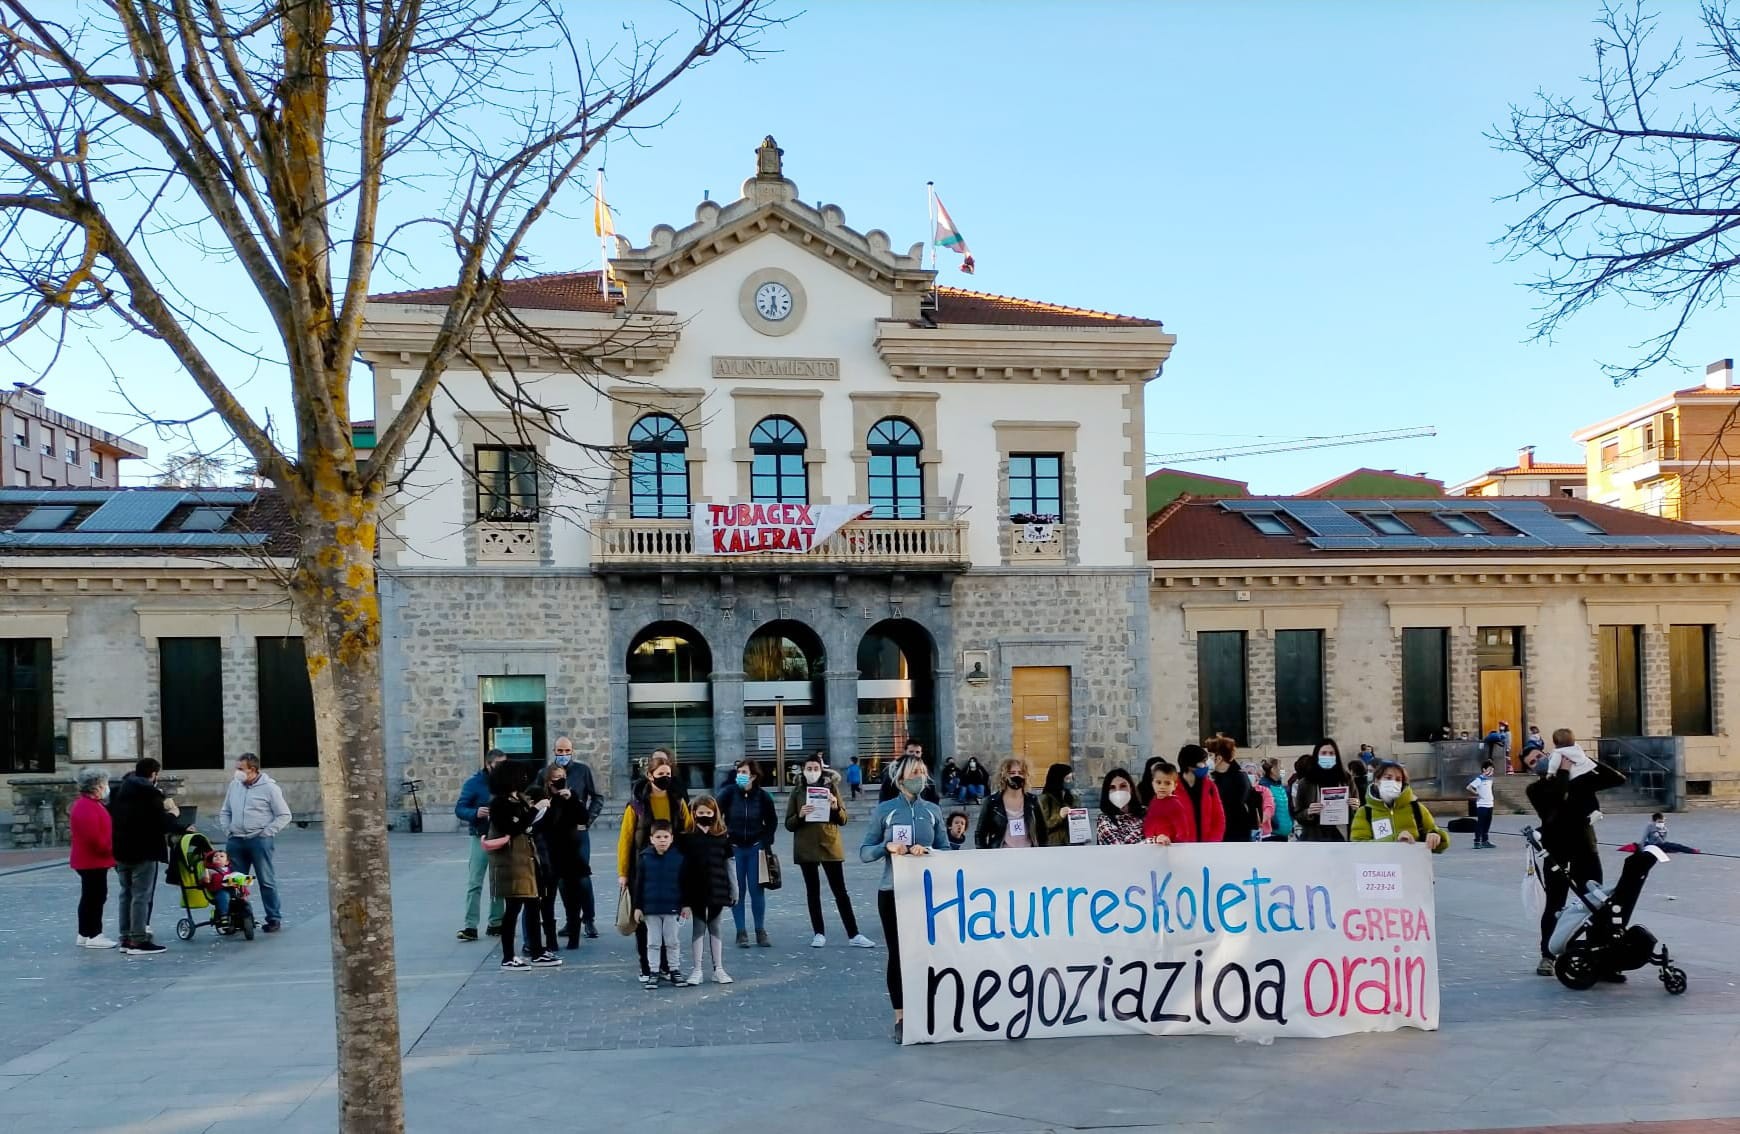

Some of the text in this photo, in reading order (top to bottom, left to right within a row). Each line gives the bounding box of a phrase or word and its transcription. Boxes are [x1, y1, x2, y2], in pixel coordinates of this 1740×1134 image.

[717, 359, 835, 377] AYUNTAMIENTO
[707, 503, 814, 526] TUBACEX
[712, 527, 816, 553] KALERAT
[1362, 870, 1396, 878] OTSAILAK
[1365, 884, 1395, 892] 22-23-24
[923, 867, 1336, 944] Haurreskoletan
[1343, 907, 1431, 941] GREBA
[927, 945, 1427, 1040] negoziazioa orain
